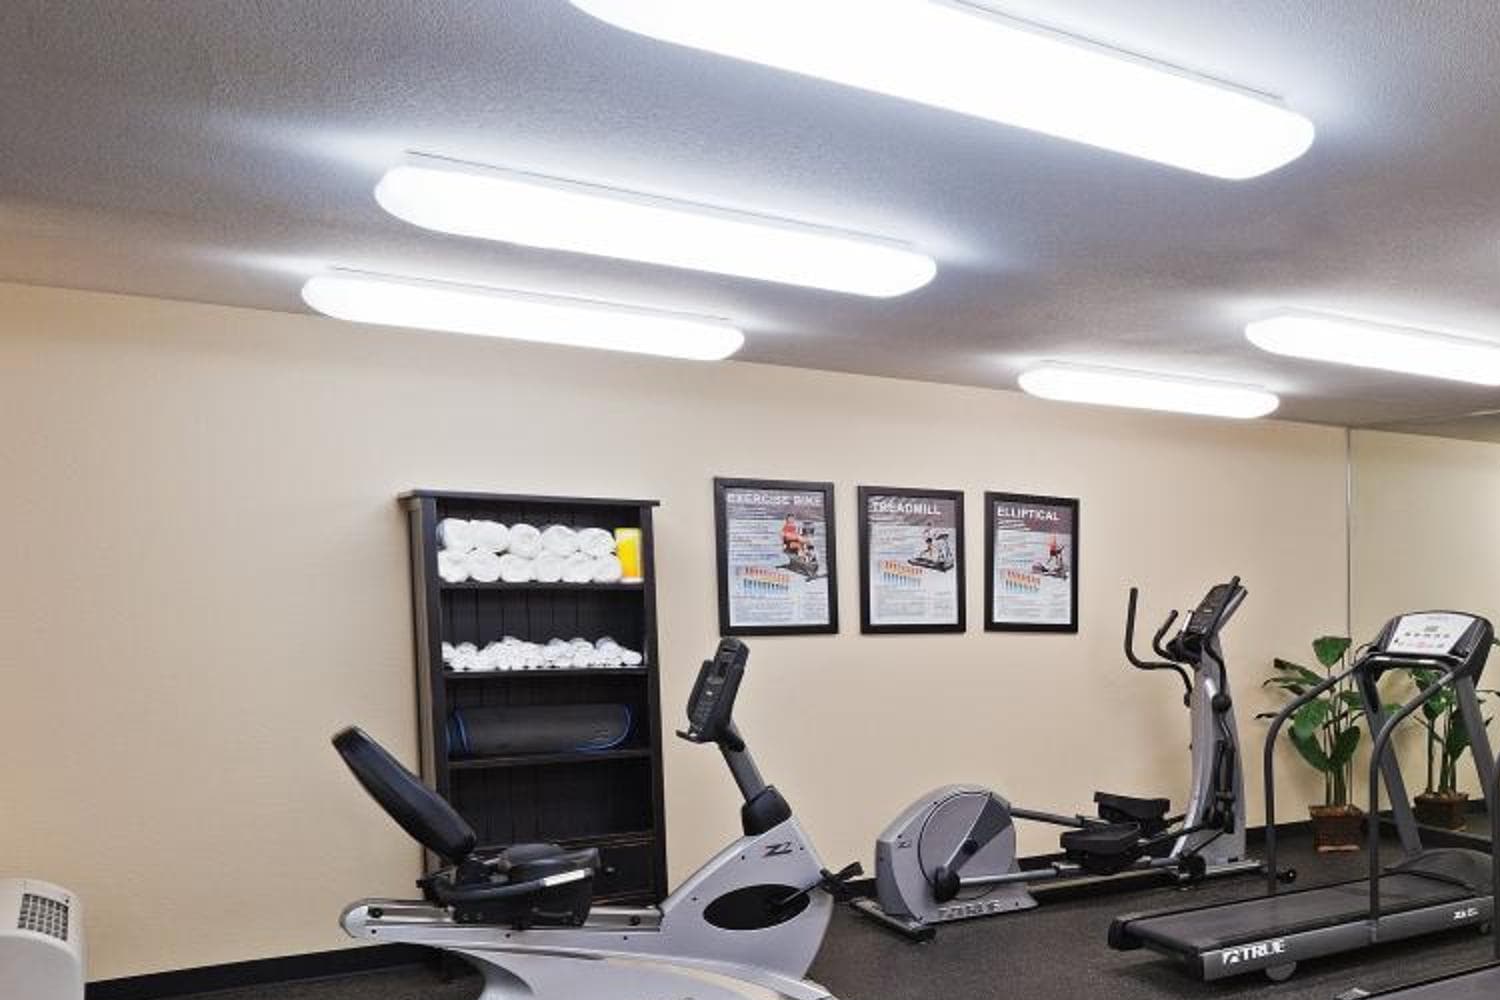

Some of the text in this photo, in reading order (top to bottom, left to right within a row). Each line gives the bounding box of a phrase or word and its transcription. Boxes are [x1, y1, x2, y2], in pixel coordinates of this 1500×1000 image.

[727, 493, 823, 507] EXERCISE BIKE
[871, 502, 941, 515] TREADMILL
[997, 506, 1060, 521] ELLIPTICAL
[1239, 940, 1285, 961] TRUE
